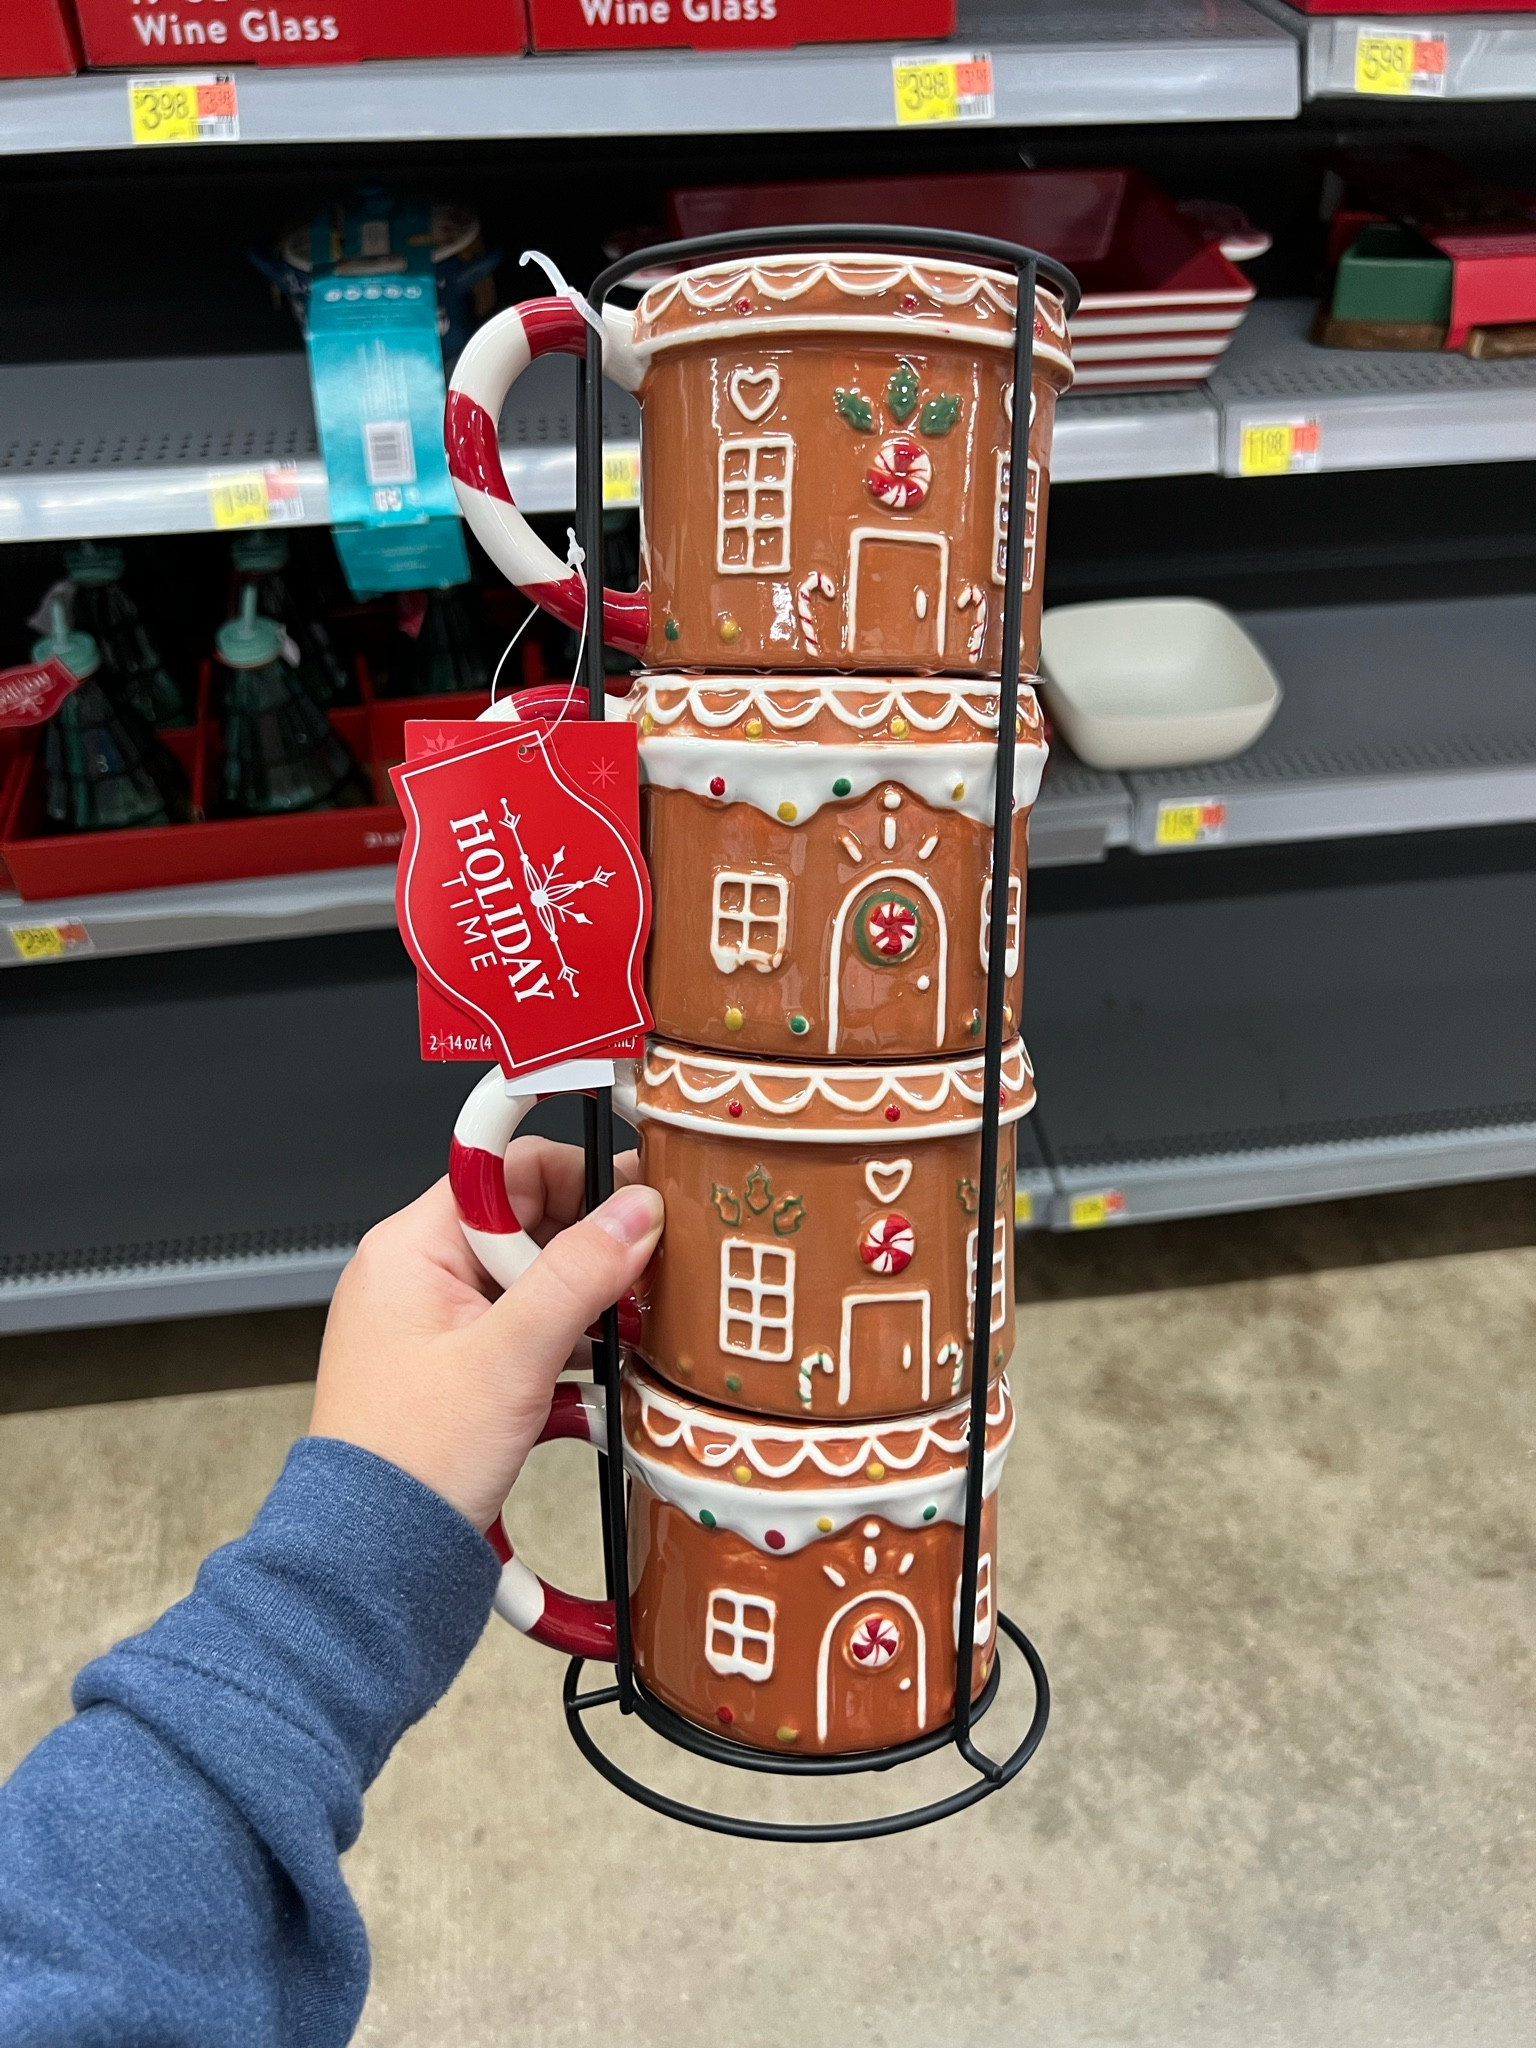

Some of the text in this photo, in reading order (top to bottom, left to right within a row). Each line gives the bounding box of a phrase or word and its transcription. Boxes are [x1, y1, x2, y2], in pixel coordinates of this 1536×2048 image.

[132, 9, 339, 46] Wine Glass
[580, 0, 777, 26] Wine Glass
[441, 870, 498, 972] TIME
[449, 809, 555, 1003] HOLIDAY
[464, 1038, 478, 1050] oz
